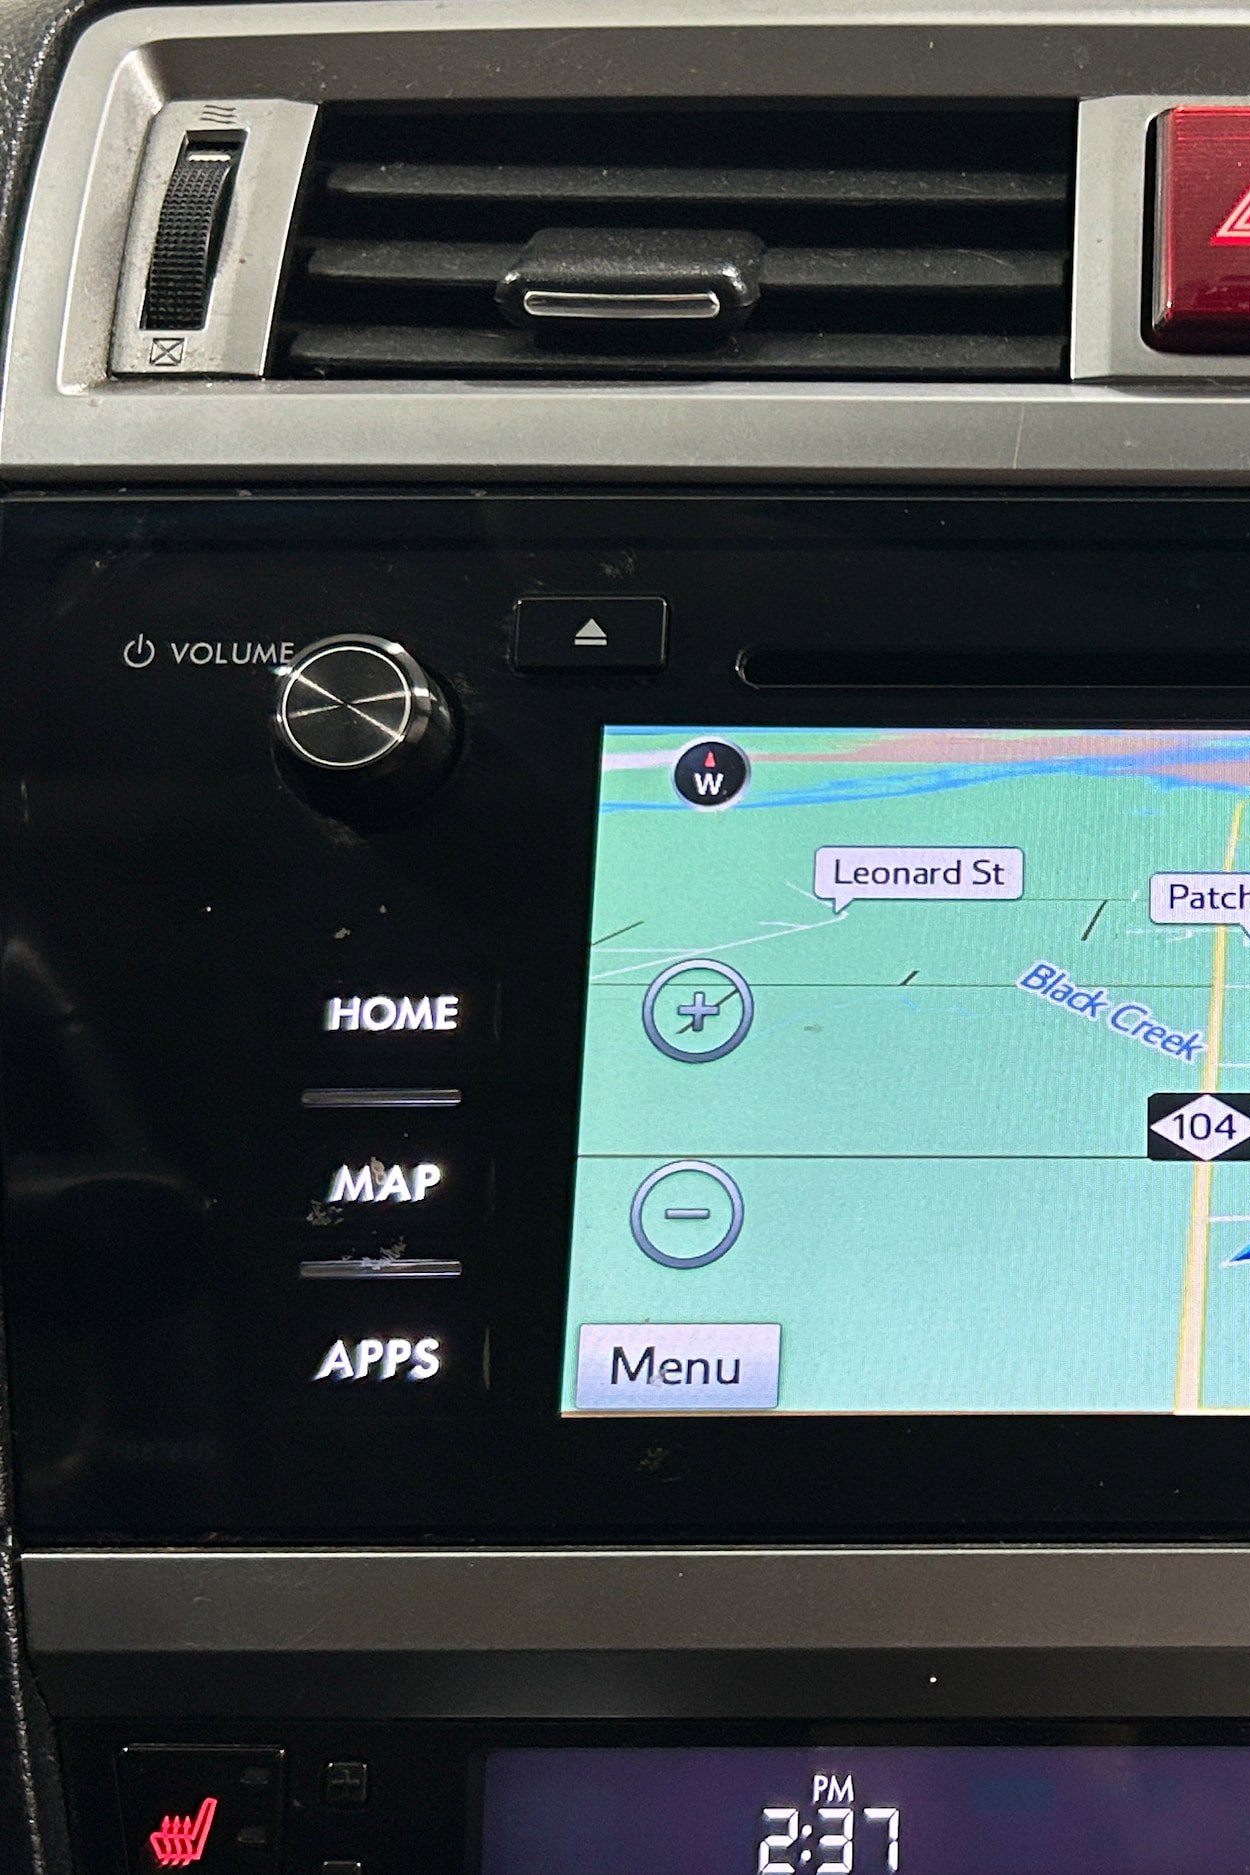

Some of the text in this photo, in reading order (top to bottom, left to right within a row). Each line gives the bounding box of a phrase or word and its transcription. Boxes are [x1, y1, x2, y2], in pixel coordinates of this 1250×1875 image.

[171, 642, 295, 665] VOLUME
[694, 773, 724, 795] W
[834, 859, 1005, 885] Leonard St
[326, 995, 459, 1031] HOME
[1020, 963, 1204, 1062] Black Creek
[1172, 1113, 1237, 1140] 104
[327, 1164, 441, 1203] MAP
[312, 1338, 440, 1381] APPS
[611, 1346, 741, 1385] Menu
[812, 1774, 855, 1804] PM
[759, 1808, 900, 1875] 2:37
